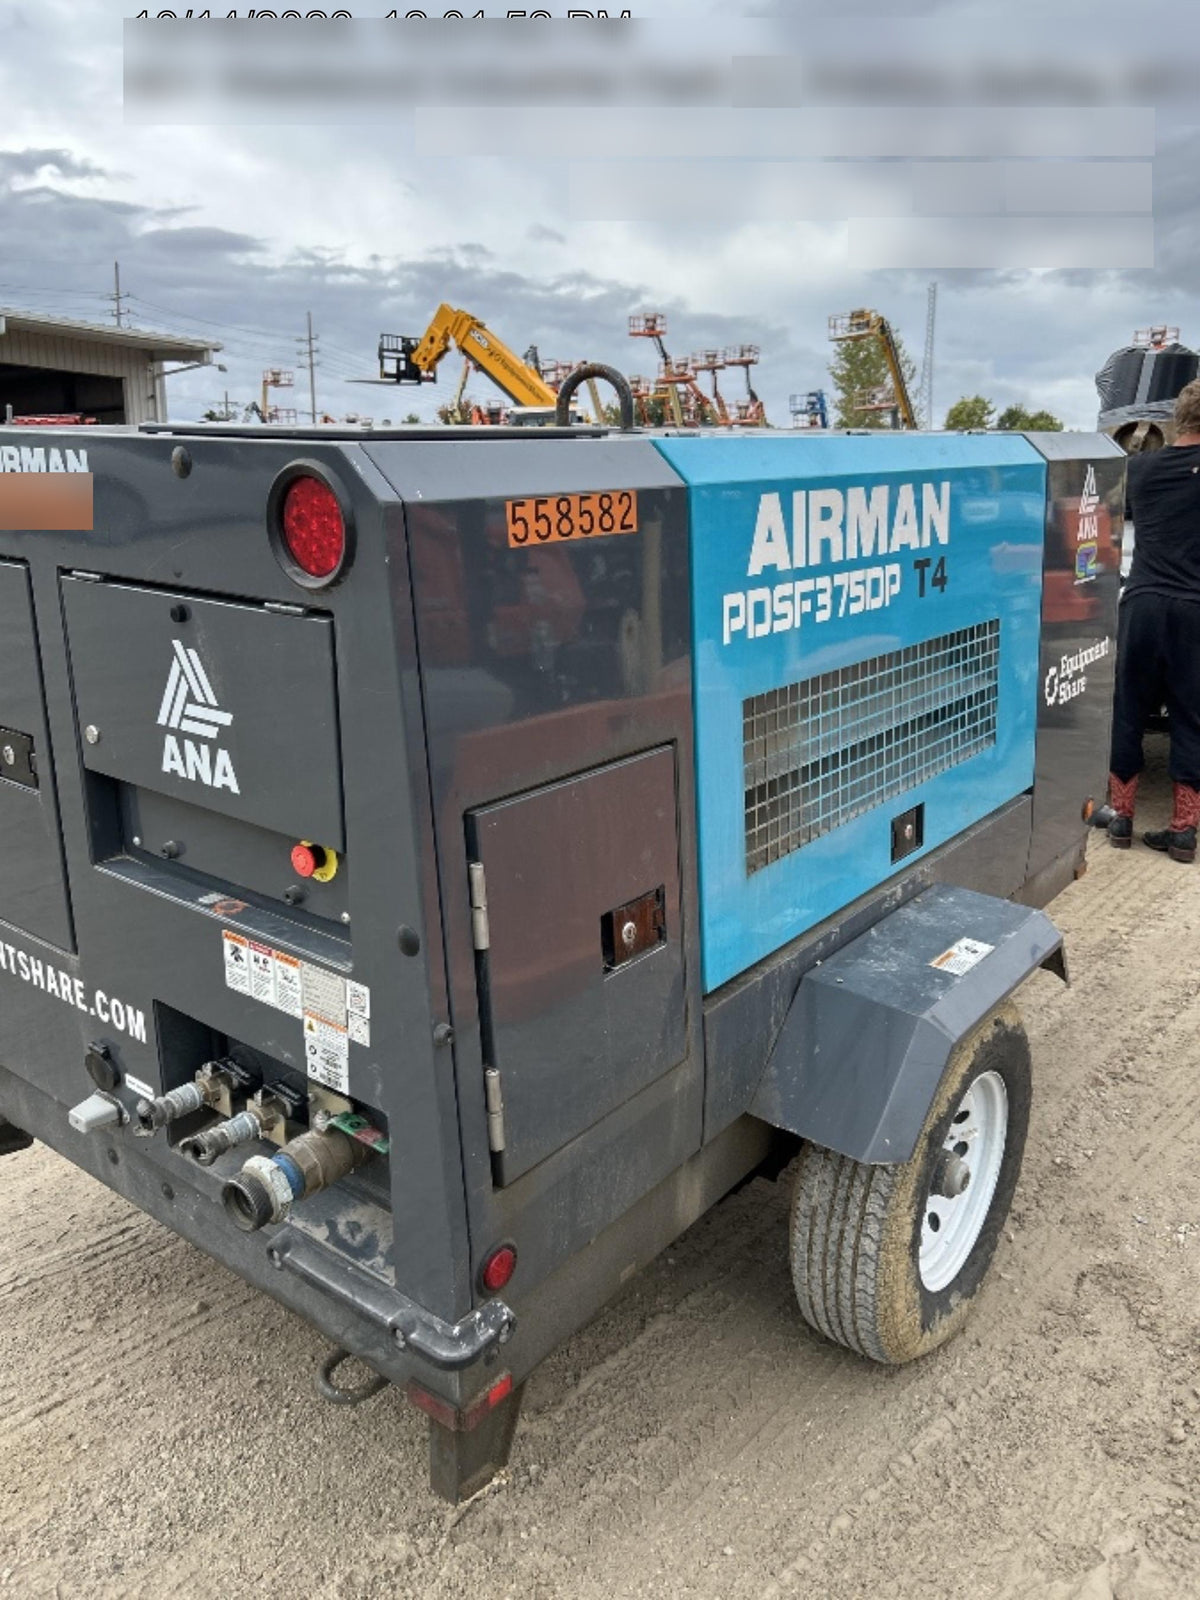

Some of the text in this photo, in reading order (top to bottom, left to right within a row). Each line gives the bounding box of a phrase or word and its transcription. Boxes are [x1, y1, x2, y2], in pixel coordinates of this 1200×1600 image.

[0, 445, 89, 473] RMAN
[511, 492, 633, 543] 558582
[747, 481, 950, 577] AIRMAN
[1077, 515, 1098, 541] ANA
[913, 556, 948, 598] T4
[161, 734, 240, 795] ANA
